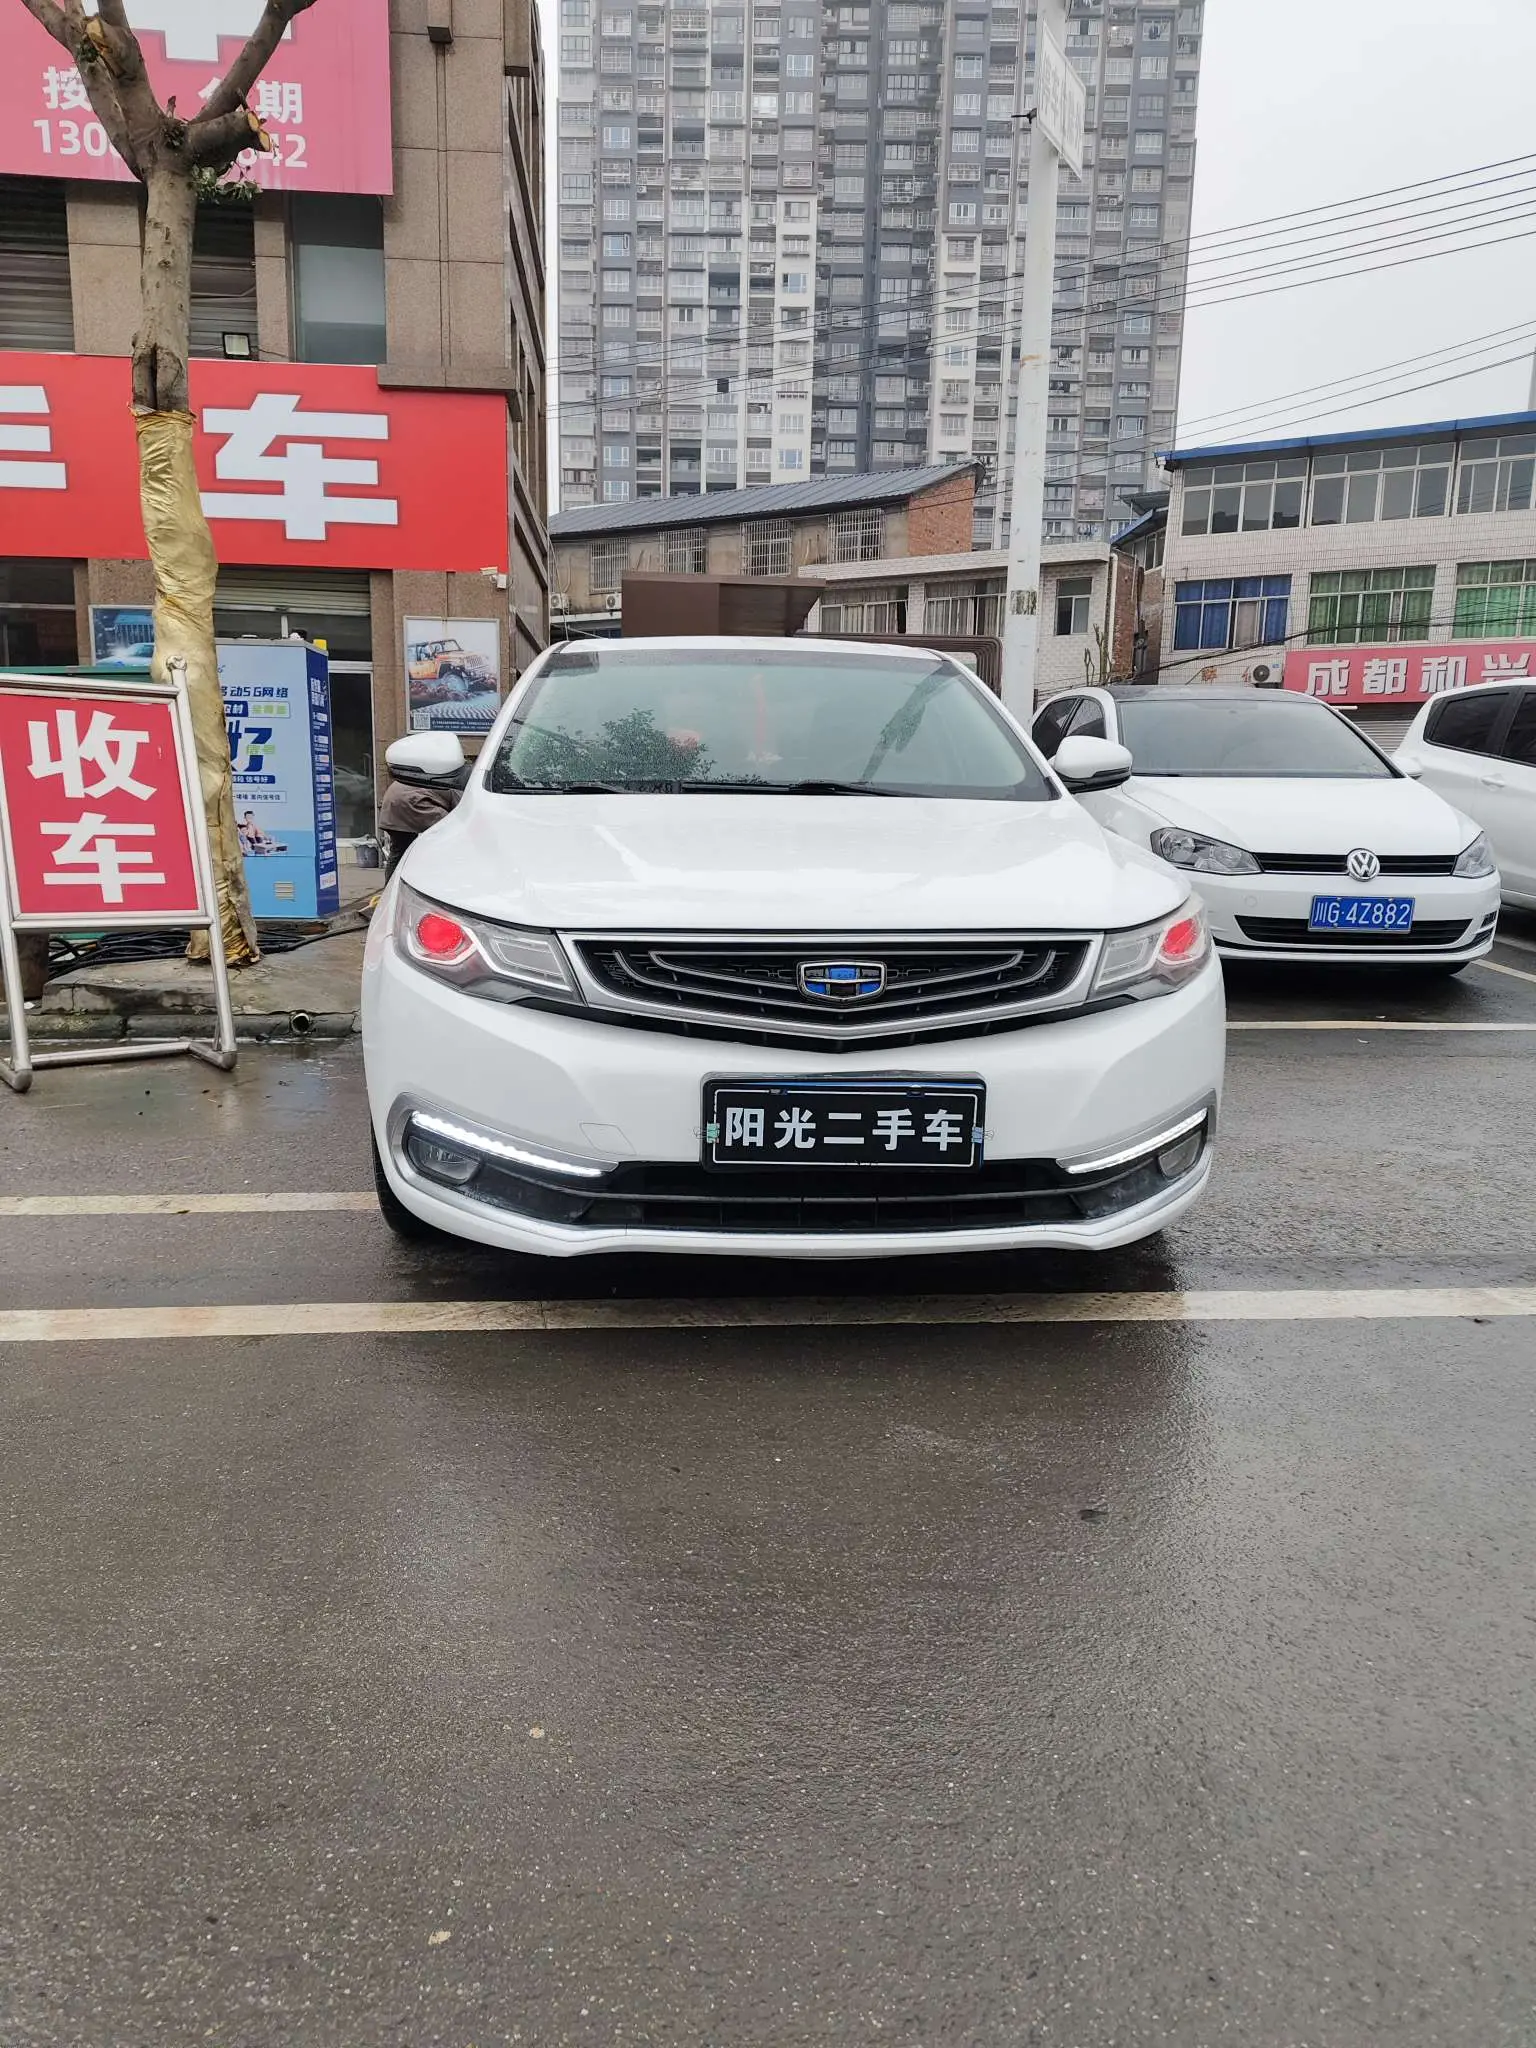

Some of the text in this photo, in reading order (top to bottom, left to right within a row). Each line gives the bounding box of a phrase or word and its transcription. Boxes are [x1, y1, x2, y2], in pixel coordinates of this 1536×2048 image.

[27, 709, 167, 904] 收车
[724, 1106, 965, 1152] 阳光二手车
